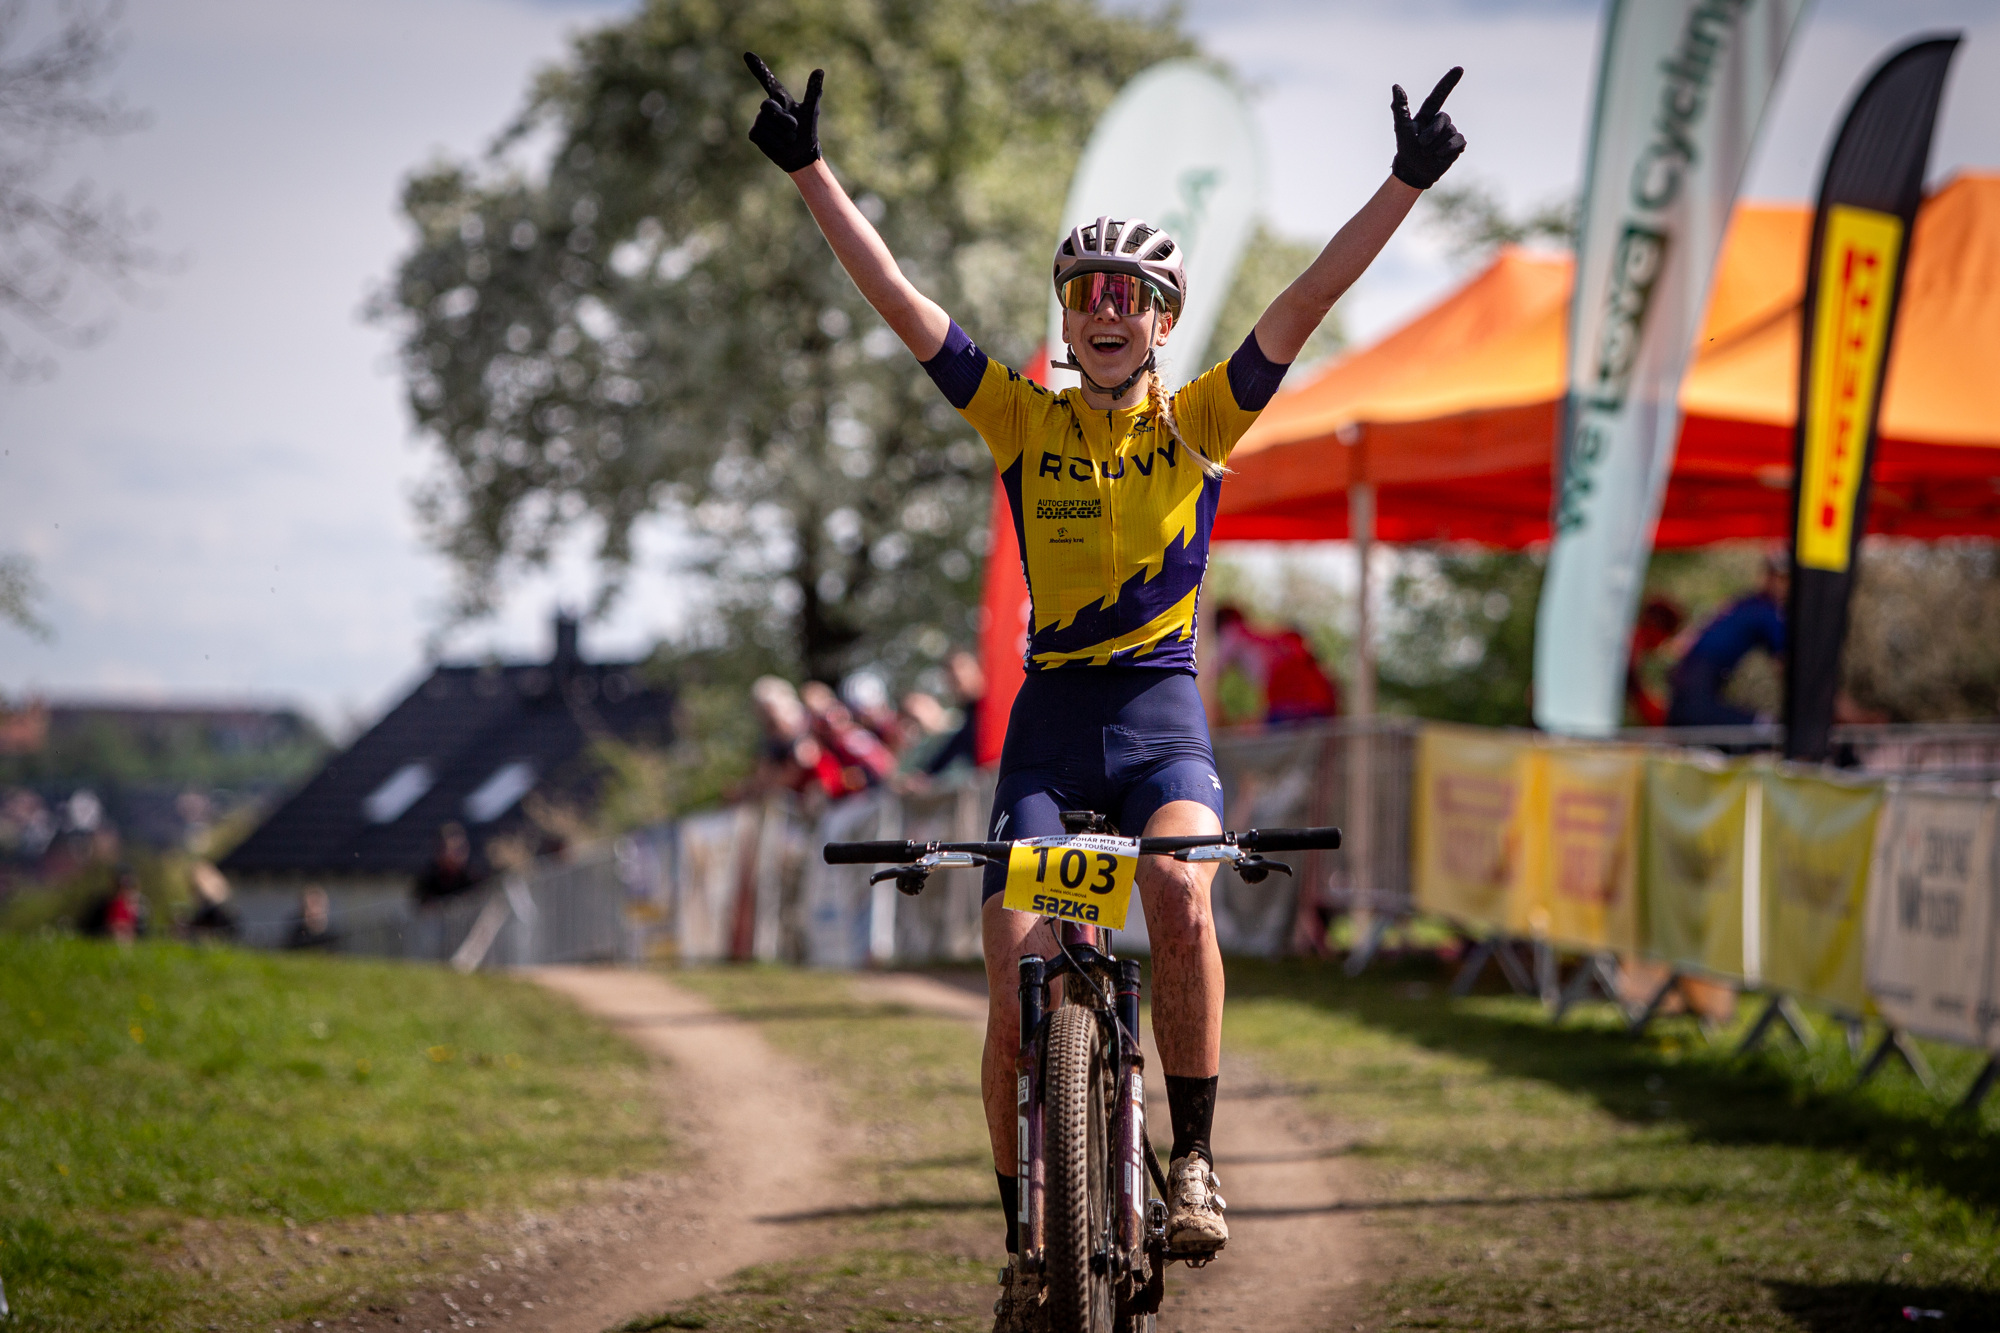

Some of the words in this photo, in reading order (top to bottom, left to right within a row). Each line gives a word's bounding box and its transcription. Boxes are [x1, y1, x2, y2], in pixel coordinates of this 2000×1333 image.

[1629, 0, 1752, 210] Cyclin
[1039, 438, 1176, 482] ROUVY
[1037, 498, 1101, 507] AUTOCENTRUM
[1084, 843, 1120, 853] TOUŠKOV
[1032, 847, 1118, 895] 103
[1032, 894, 1099, 922] sazka
